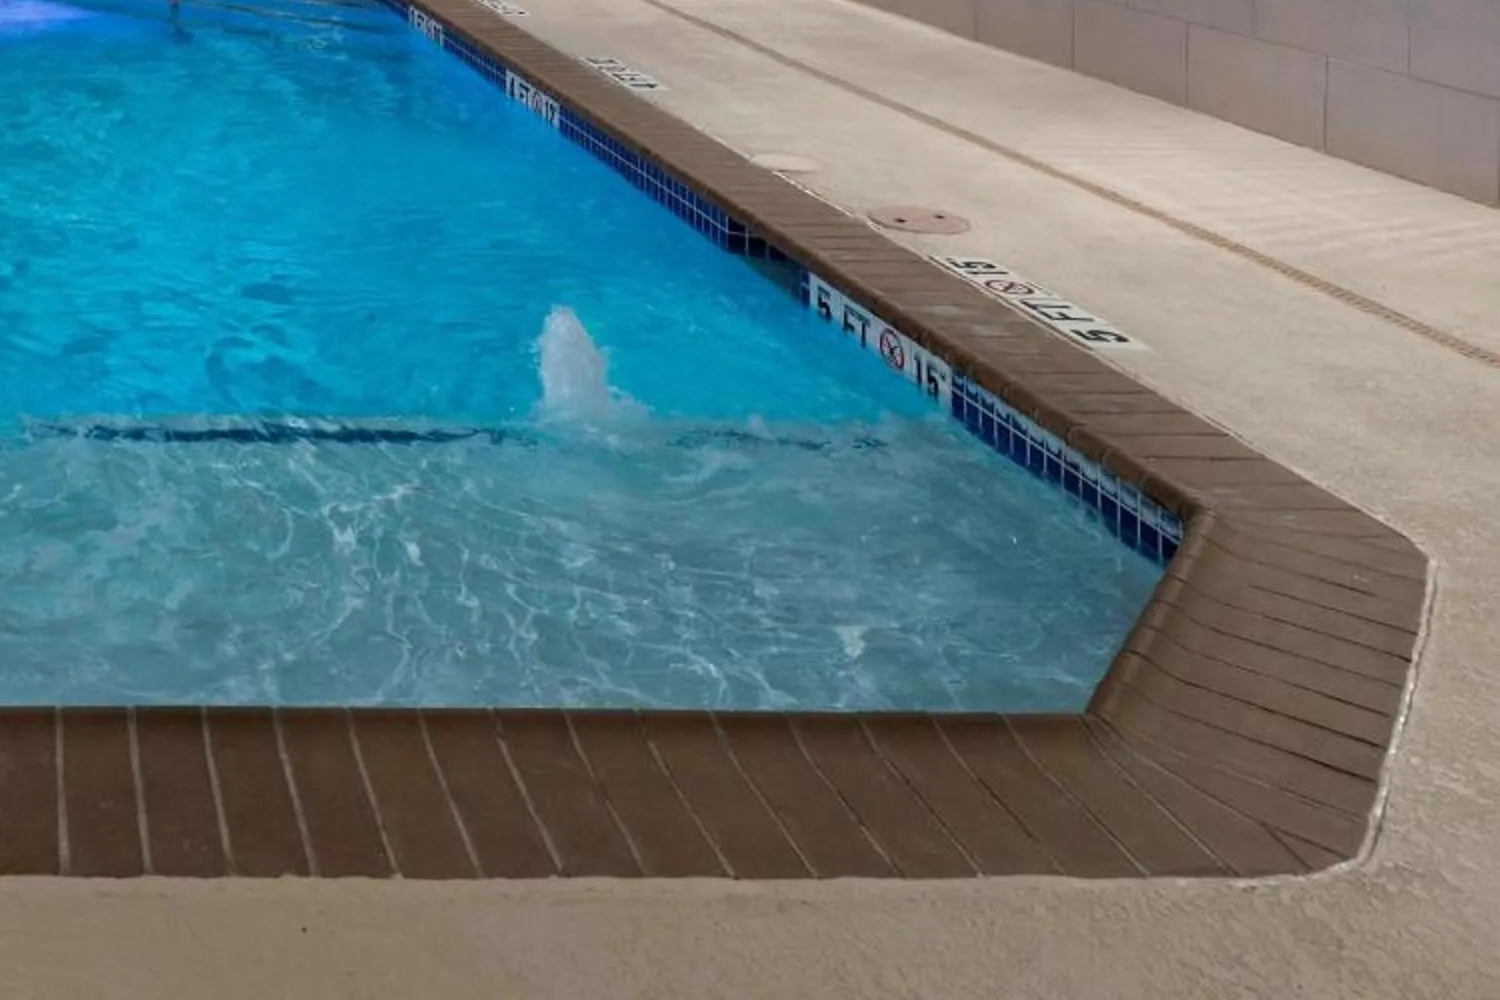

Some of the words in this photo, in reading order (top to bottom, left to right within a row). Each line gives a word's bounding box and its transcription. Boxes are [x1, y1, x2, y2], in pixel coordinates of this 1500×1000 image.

[816, 284, 833, 323] 5
[842, 303, 871, 349] FT
[1020, 300, 1096, 322] FT
